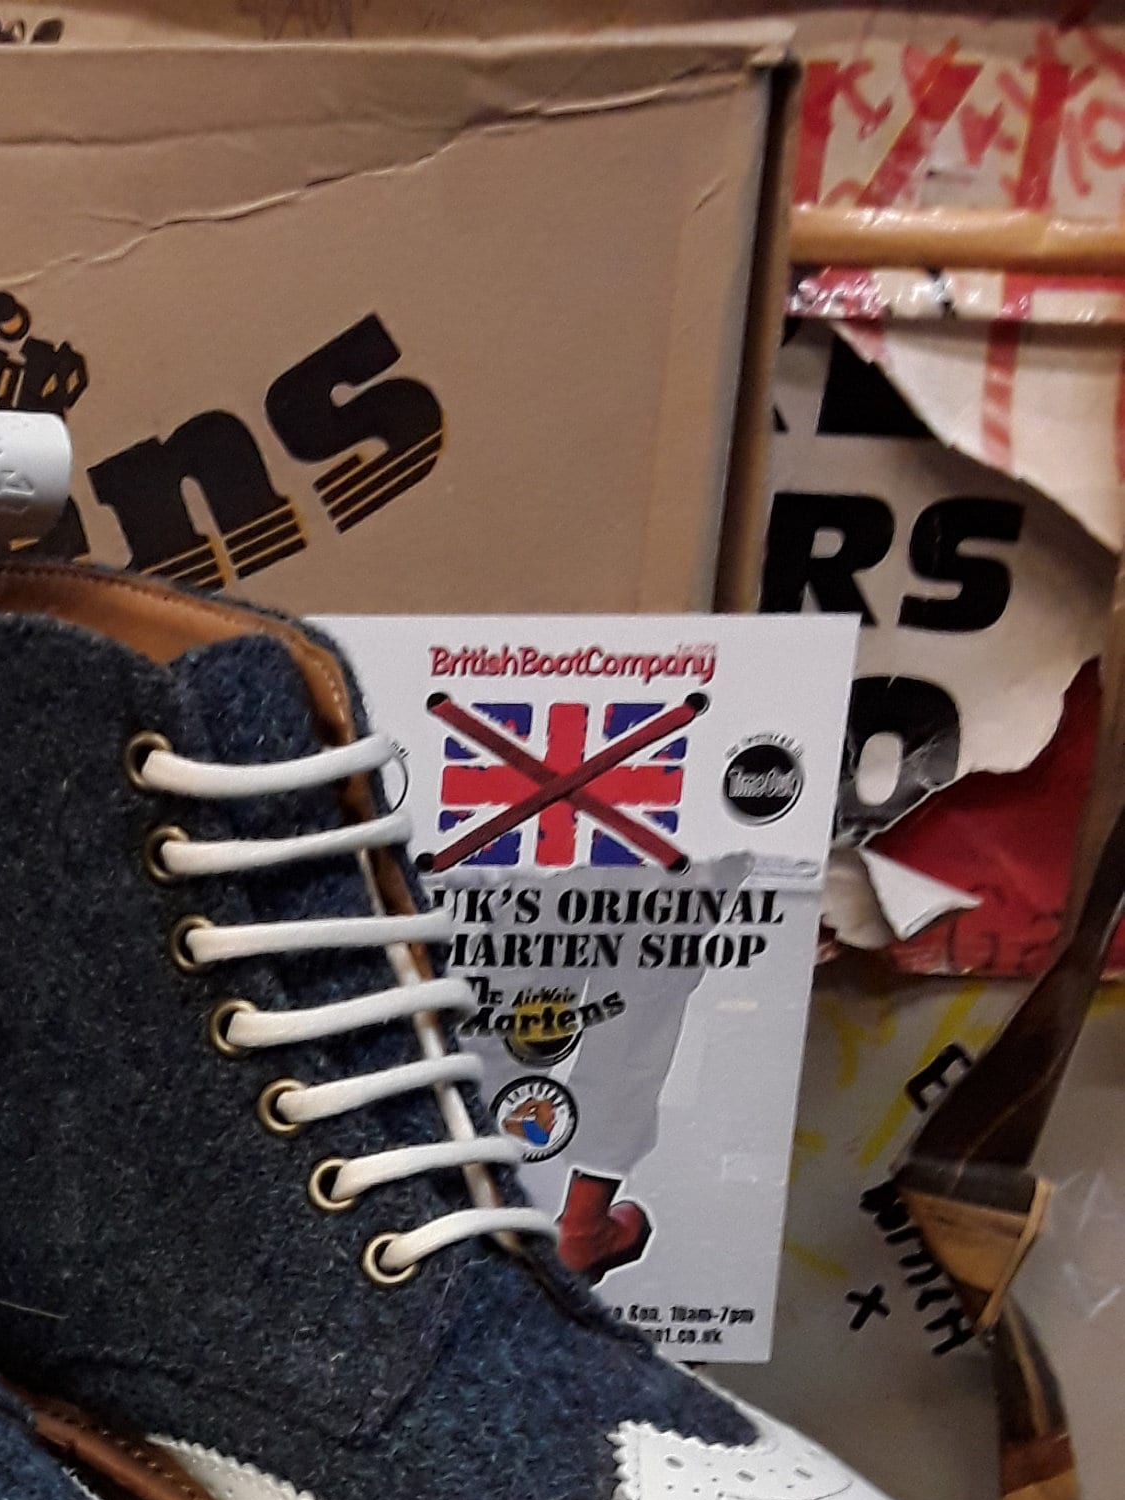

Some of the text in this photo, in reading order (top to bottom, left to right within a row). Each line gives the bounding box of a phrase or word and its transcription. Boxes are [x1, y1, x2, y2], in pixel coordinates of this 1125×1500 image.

[430, 645, 717, 686] BritishBootCompany
[556, 888, 784, 926] ORIGINAL
[636, 932, 767, 969] SHOP
